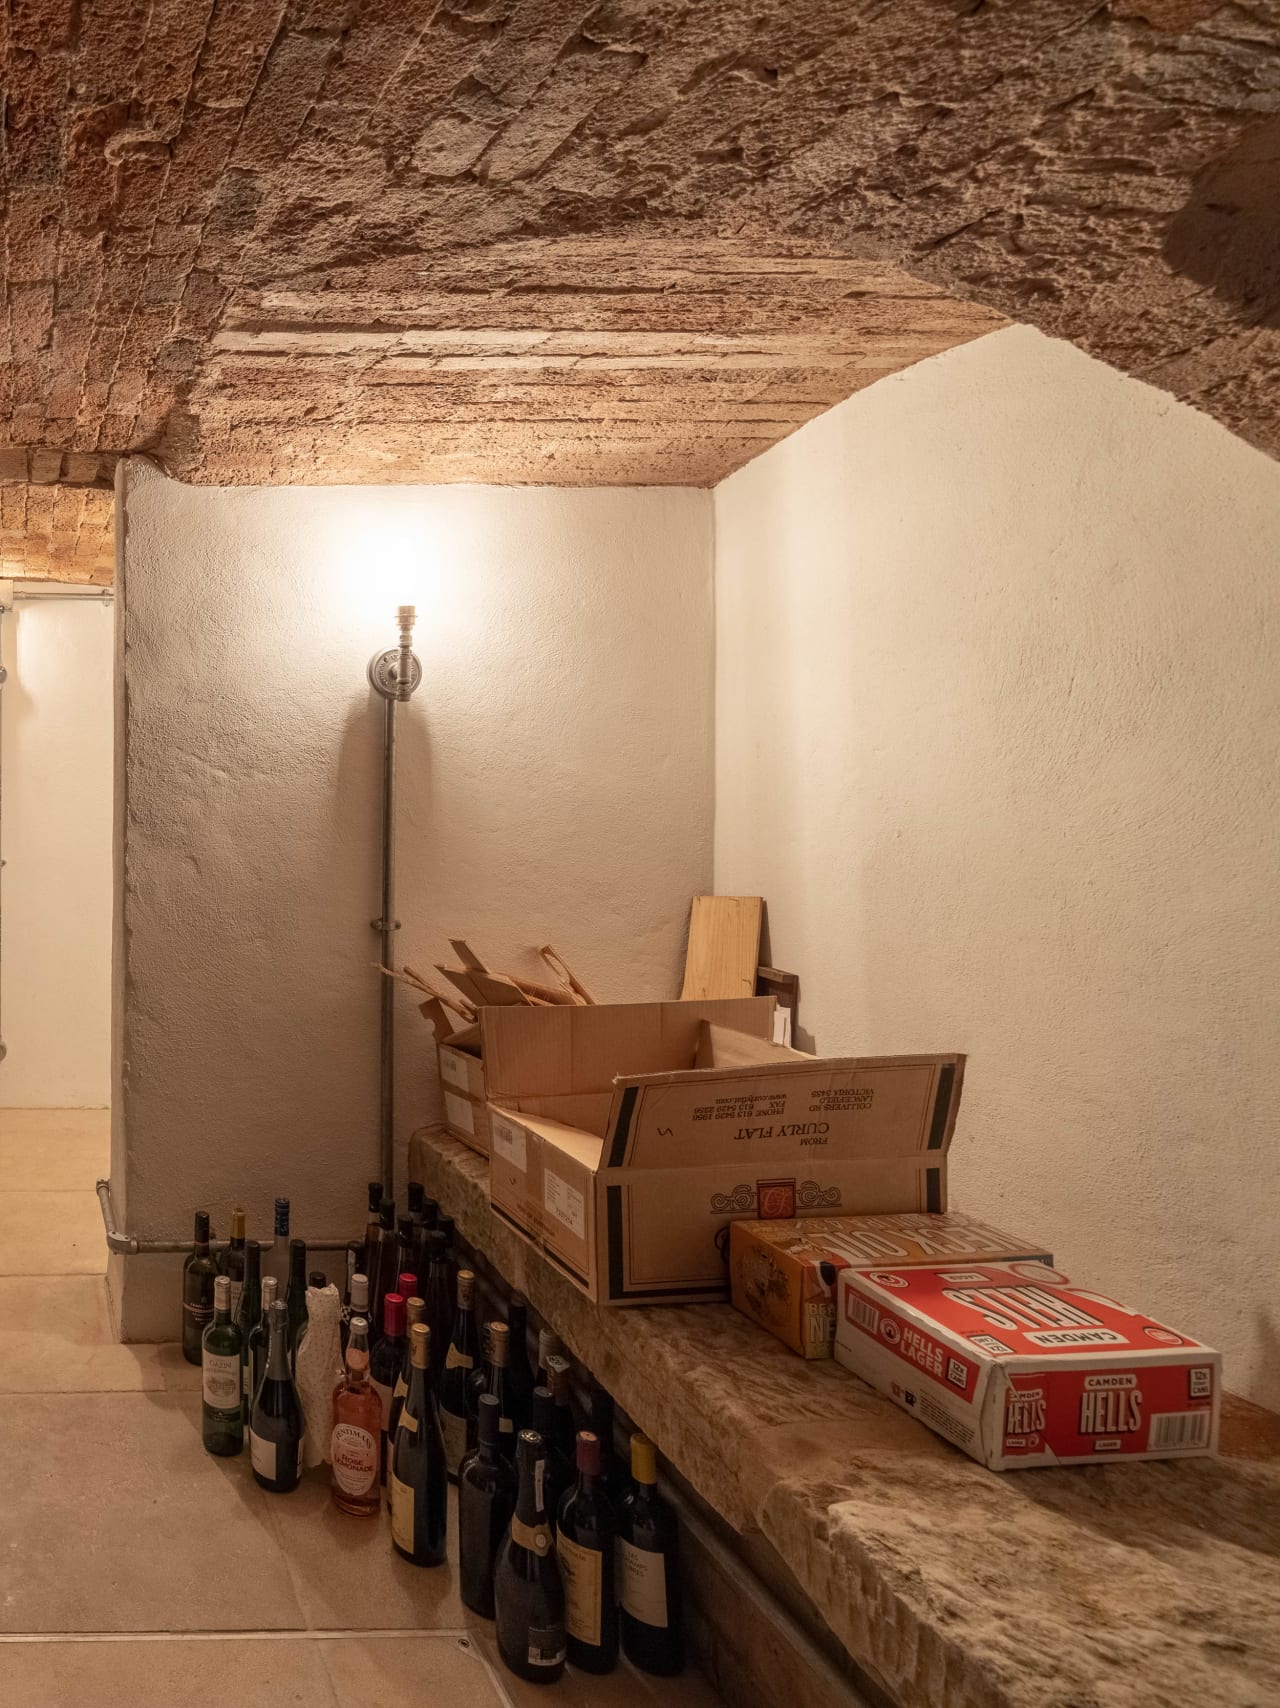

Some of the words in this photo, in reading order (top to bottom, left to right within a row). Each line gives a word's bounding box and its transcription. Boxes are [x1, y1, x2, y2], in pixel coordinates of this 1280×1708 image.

[833, 1088, 874, 1097] VICTORIA
[768, 1101, 786, 1109] FAX
[819, 1096, 873, 1104] LANCEFIELD
[755, 1108, 785, 1117] PHONE
[809, 1104, 822, 1112] RD
[734, 1126, 774, 1141] FLAT
[776, 1122, 830, 1137] CURLY
[800, 1137, 828, 1146] FROM
[806, 1228, 908, 1260] OIL
[897, 1224, 1043, 1256] NECK
[941, 1285, 1105, 1331] HELLS
[903, 1327, 944, 1362] HELLS
[1033, 1331, 1116, 1344] CAMDEN
[900, 1339, 944, 1377] LAGER
[1088, 1377, 1134, 1387] CAMDEN
[1080, 1390, 1144, 1434] HELLS
[334, 1454, 375, 1473] LEMONADE
[342, 1454, 363, 1466] ROSE
